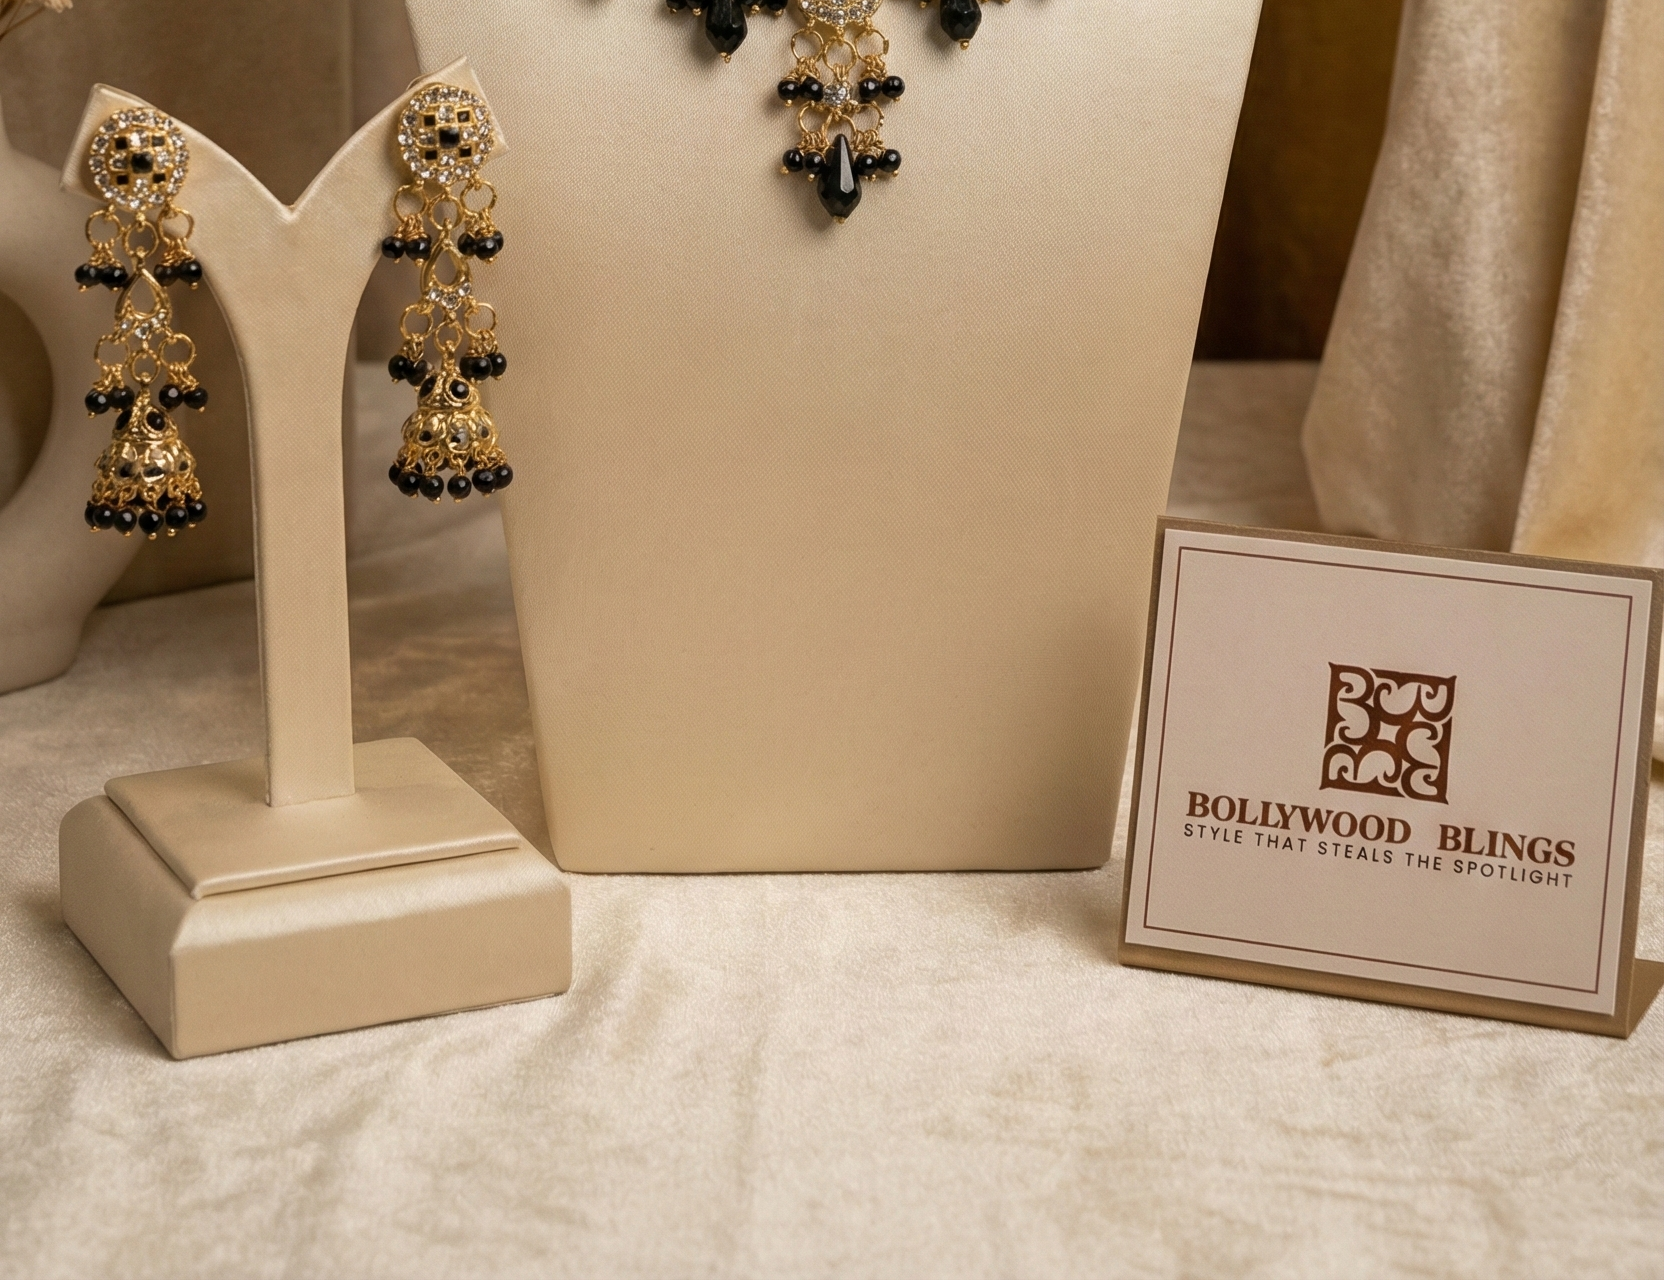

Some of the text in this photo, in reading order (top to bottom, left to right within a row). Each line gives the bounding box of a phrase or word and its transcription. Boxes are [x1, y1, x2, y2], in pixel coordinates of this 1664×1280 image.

[1183, 822, 1574, 889] STYLE THAT STEALS THE SPOTLIGHT
[1185, 790, 1576, 868] BOLLYWOOD BLINGS
